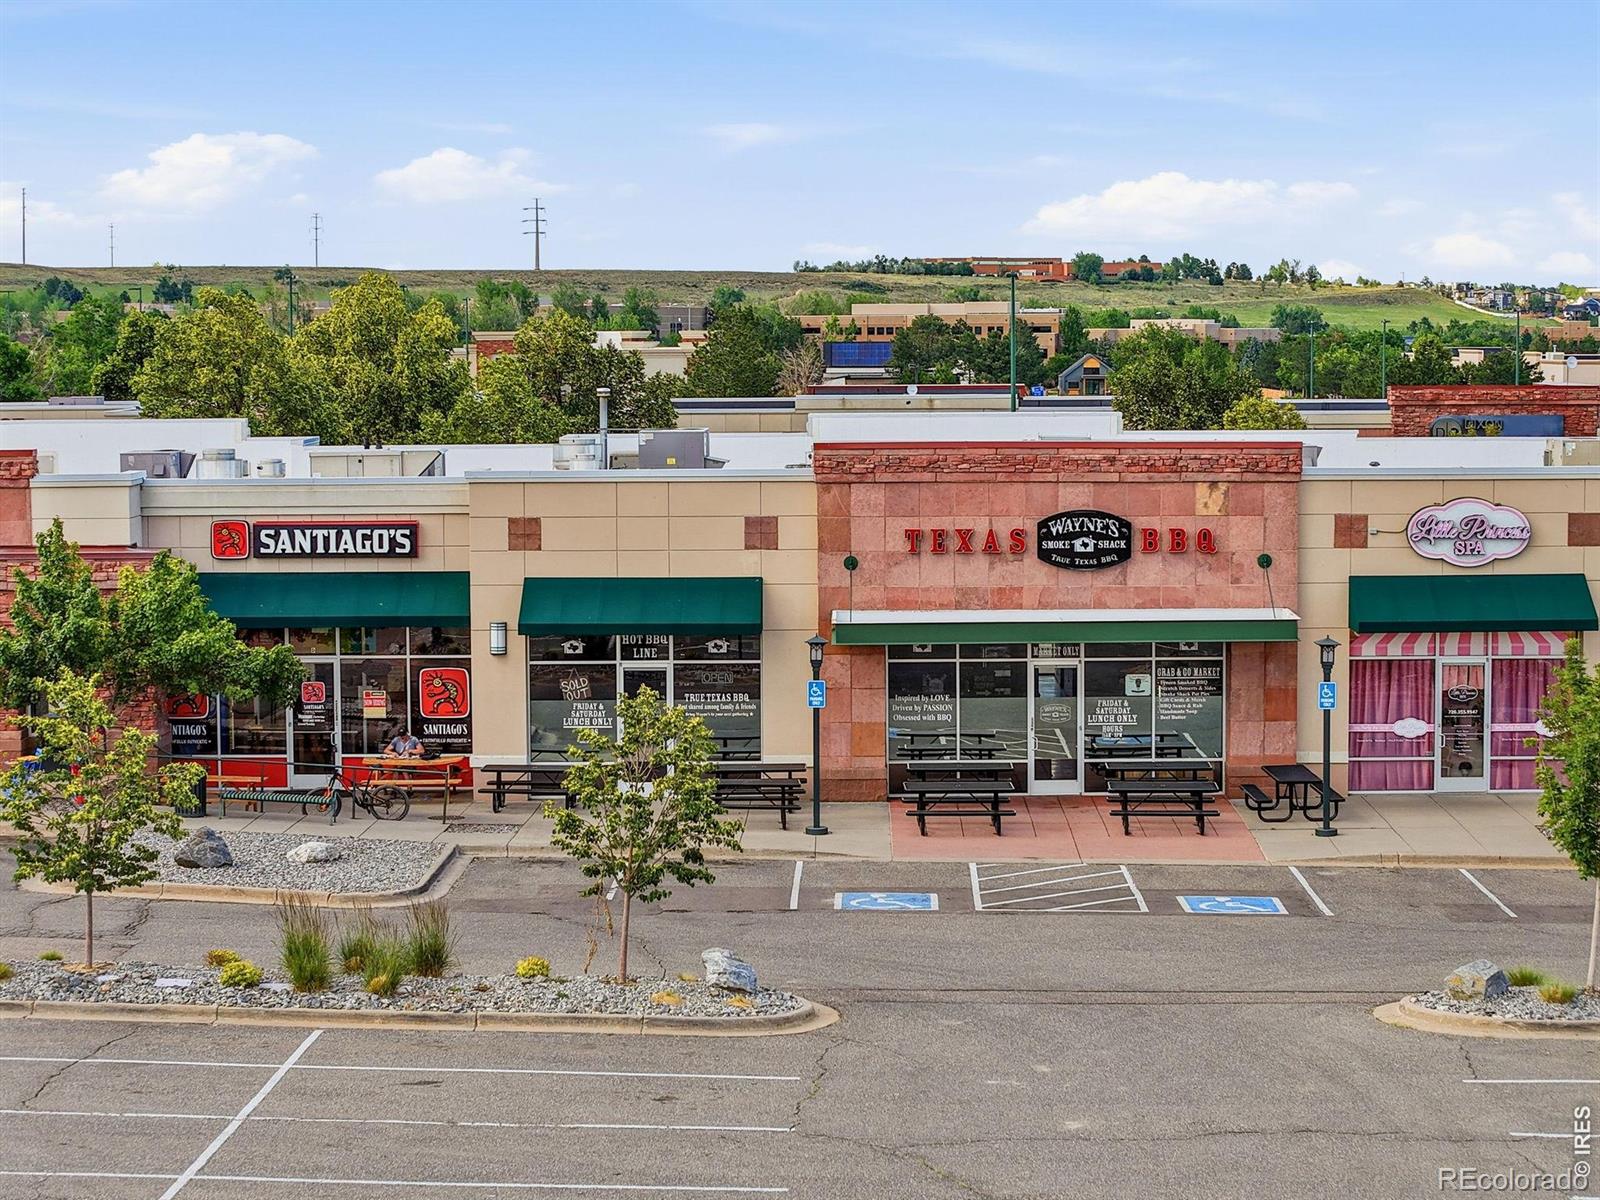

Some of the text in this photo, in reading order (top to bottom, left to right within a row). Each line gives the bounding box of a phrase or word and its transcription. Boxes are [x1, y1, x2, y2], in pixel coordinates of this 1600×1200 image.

[1048, 517, 1119, 537] WAYNE'S
[1411, 514, 1531, 546] Little Princess
[260, 529, 411, 554] SANTIAGO'S
[904, 528, 1027, 555] TEXAS
[1041, 540, 1126, 549] SMOKE SHACK
[1140, 527, 1217, 555] BBQ
[1455, 540, 1486, 556] SPA
[1100, 554, 1119, 564] BBQ
[622, 635, 668, 645] HOT BBQ
[633, 648, 658, 658] LINE
[1062, 646, 1080, 656] ONLY
[1157, 667, 1220, 676] GRAB & GO MARKET
[703, 673, 732, 682] OPEN
[561, 678, 588, 693] SOLD
[566, 688, 589, 701] OUT
[684, 693, 750, 702] TRUE TEXAS BBQ
[921, 695, 929, 703] by
[930, 694, 950, 702] LOVE
[563, 718, 613, 726] LUNCH ONLY
[423, 724, 468, 735] SANTIAGO'S
